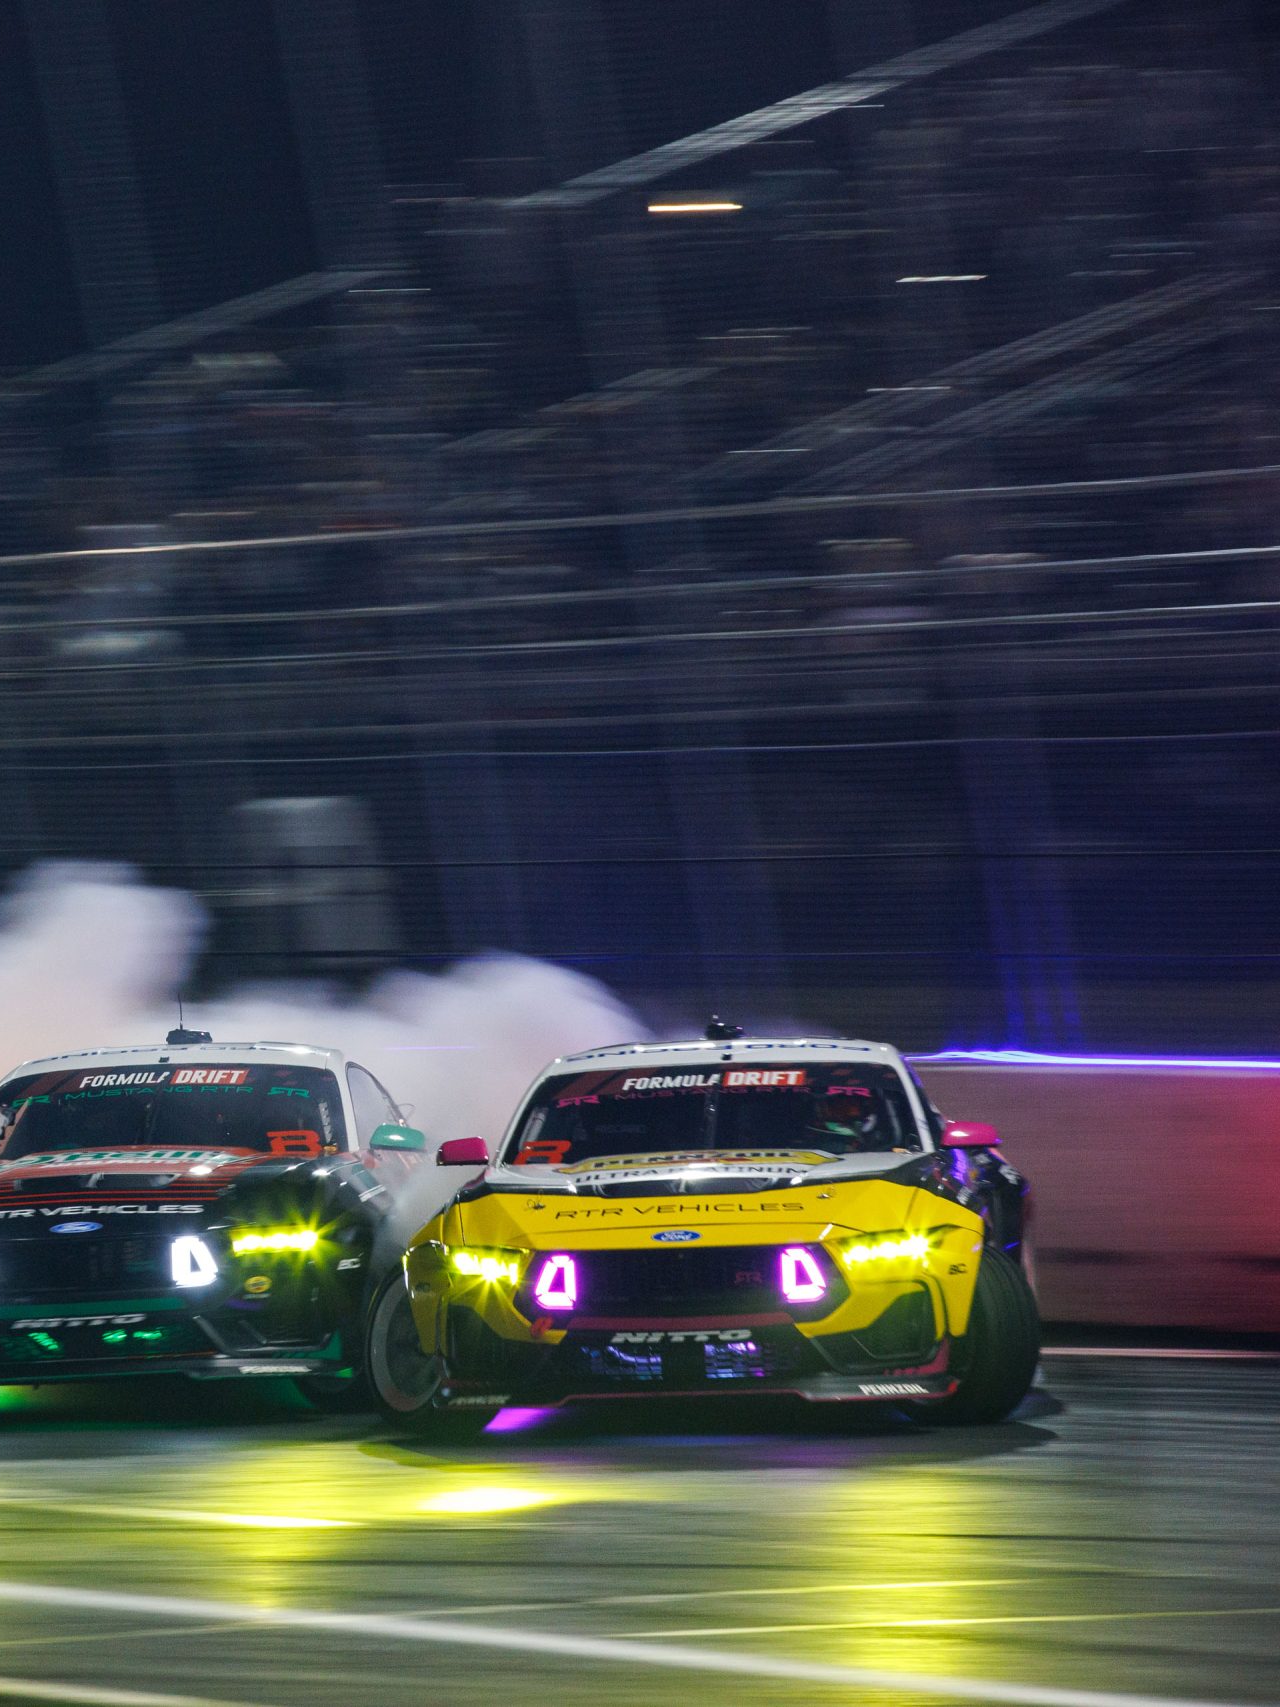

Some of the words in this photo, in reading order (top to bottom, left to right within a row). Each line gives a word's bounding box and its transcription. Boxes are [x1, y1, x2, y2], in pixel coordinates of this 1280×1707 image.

[174, 1069, 245, 1085] DRIFT
[622, 1073, 720, 1091] FORMULA
[727, 1071, 804, 1086] DRIFT
[200, 1085, 254, 1094] RTR
[575, 1168, 659, 1184] ULTRA
[39, 1204, 205, 1216] VEHICLES
[554, 1207, 625, 1220] RTR
[632, 1202, 806, 1215] VEHICLES
[11, 1312, 146, 1330] NITTO
[611, 1328, 754, 1345] NITTO
[858, 1383, 930, 1396] PENNZOIL
